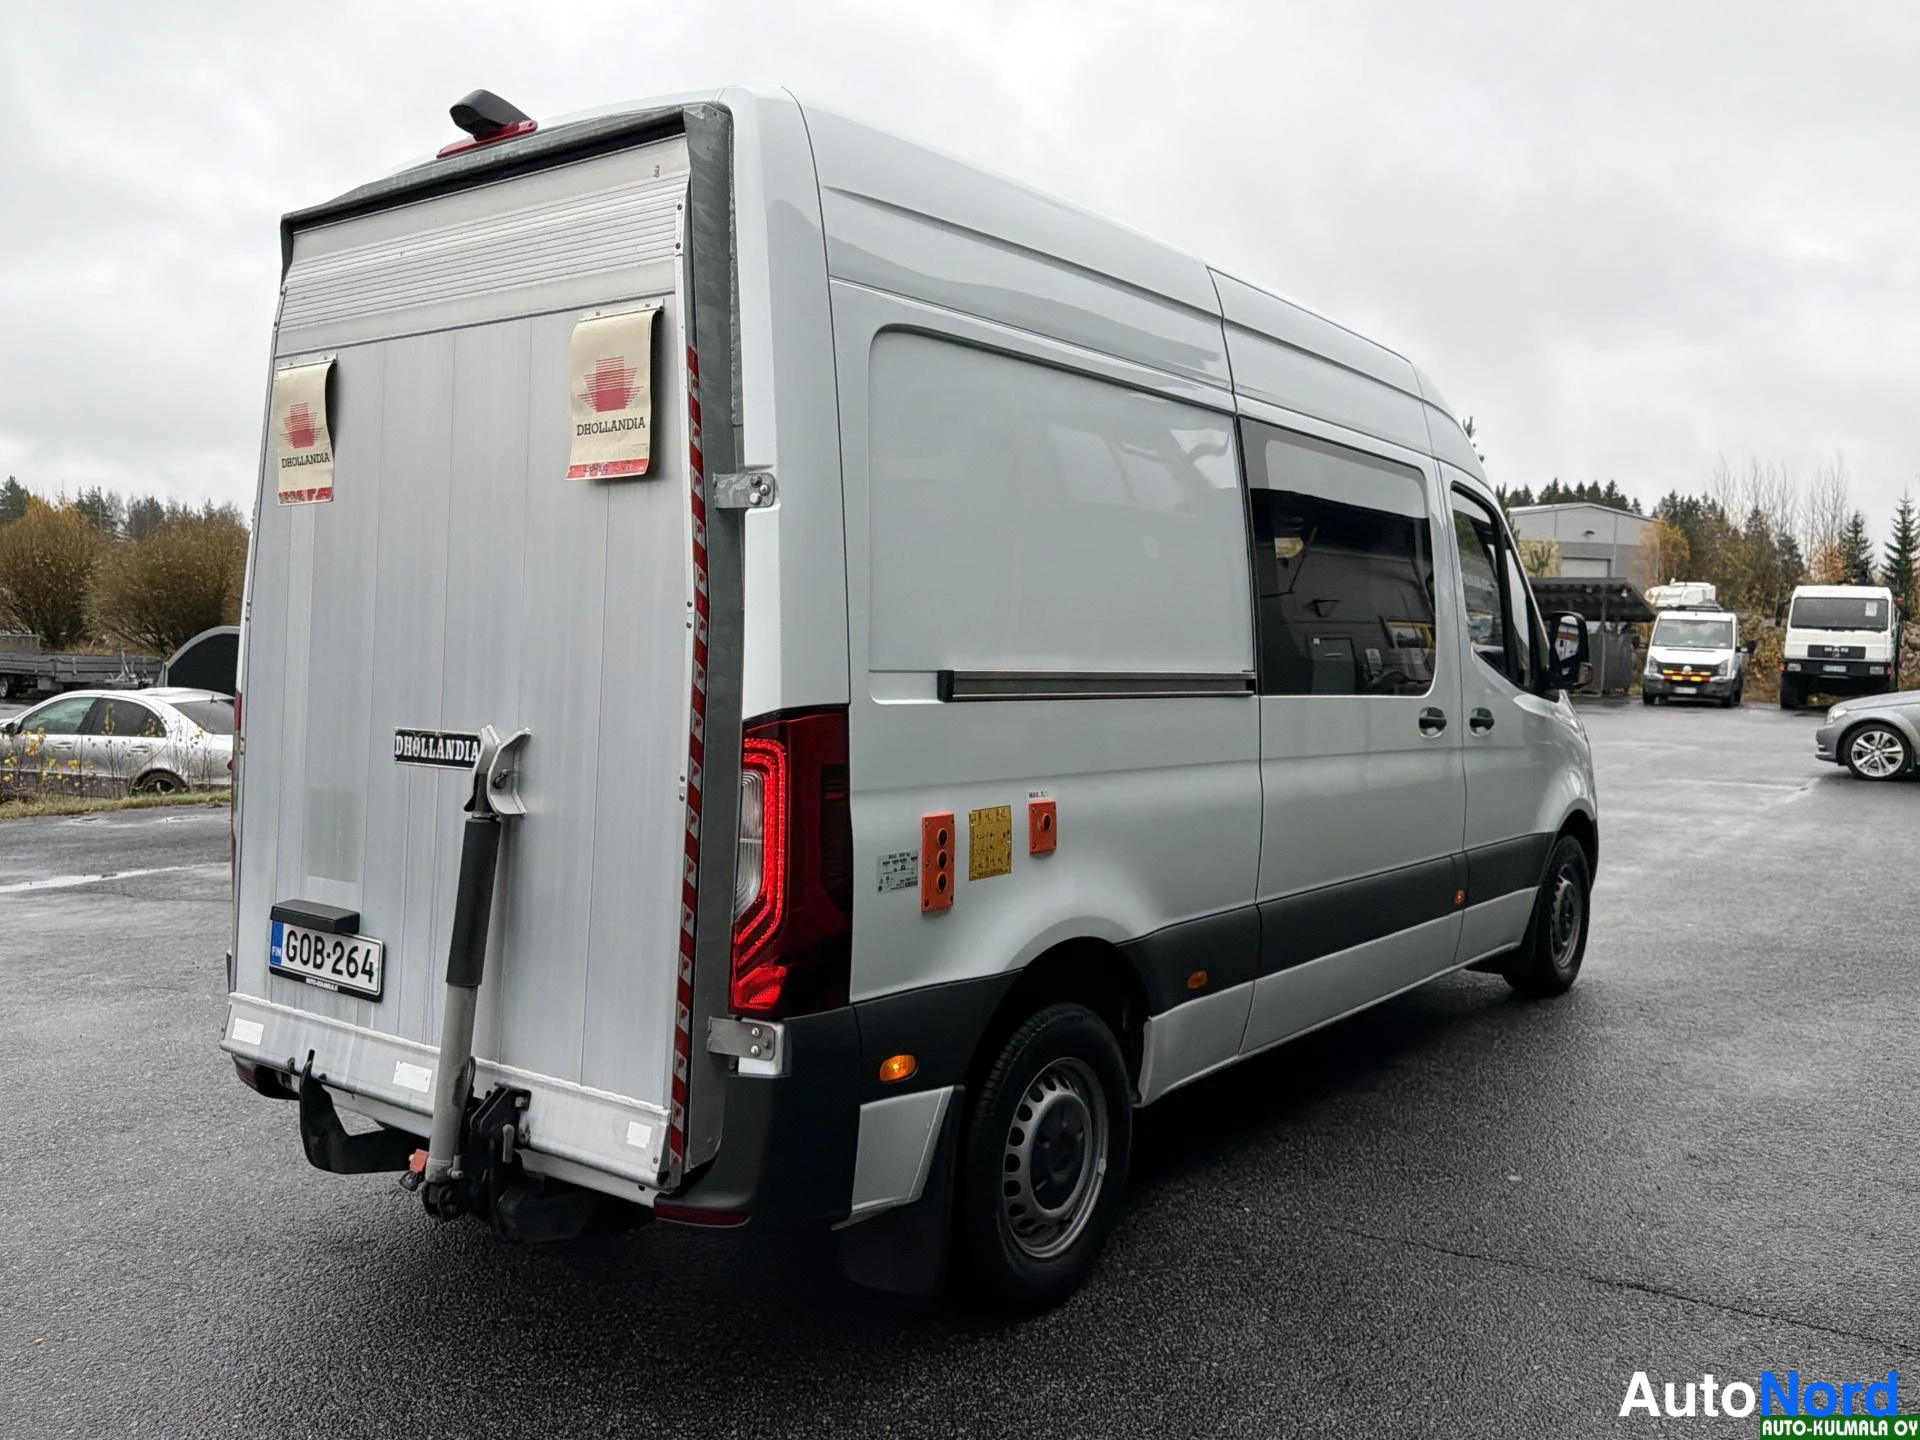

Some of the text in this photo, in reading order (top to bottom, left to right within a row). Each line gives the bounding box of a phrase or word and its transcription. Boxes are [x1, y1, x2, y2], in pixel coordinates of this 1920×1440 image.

[576, 416, 646, 437] DHOLLANDIA
[281, 452, 331, 469] DHOLLANDIA
[395, 735, 480, 762] DHOLLANDIA
[286, 929, 375, 984] GOB-264
